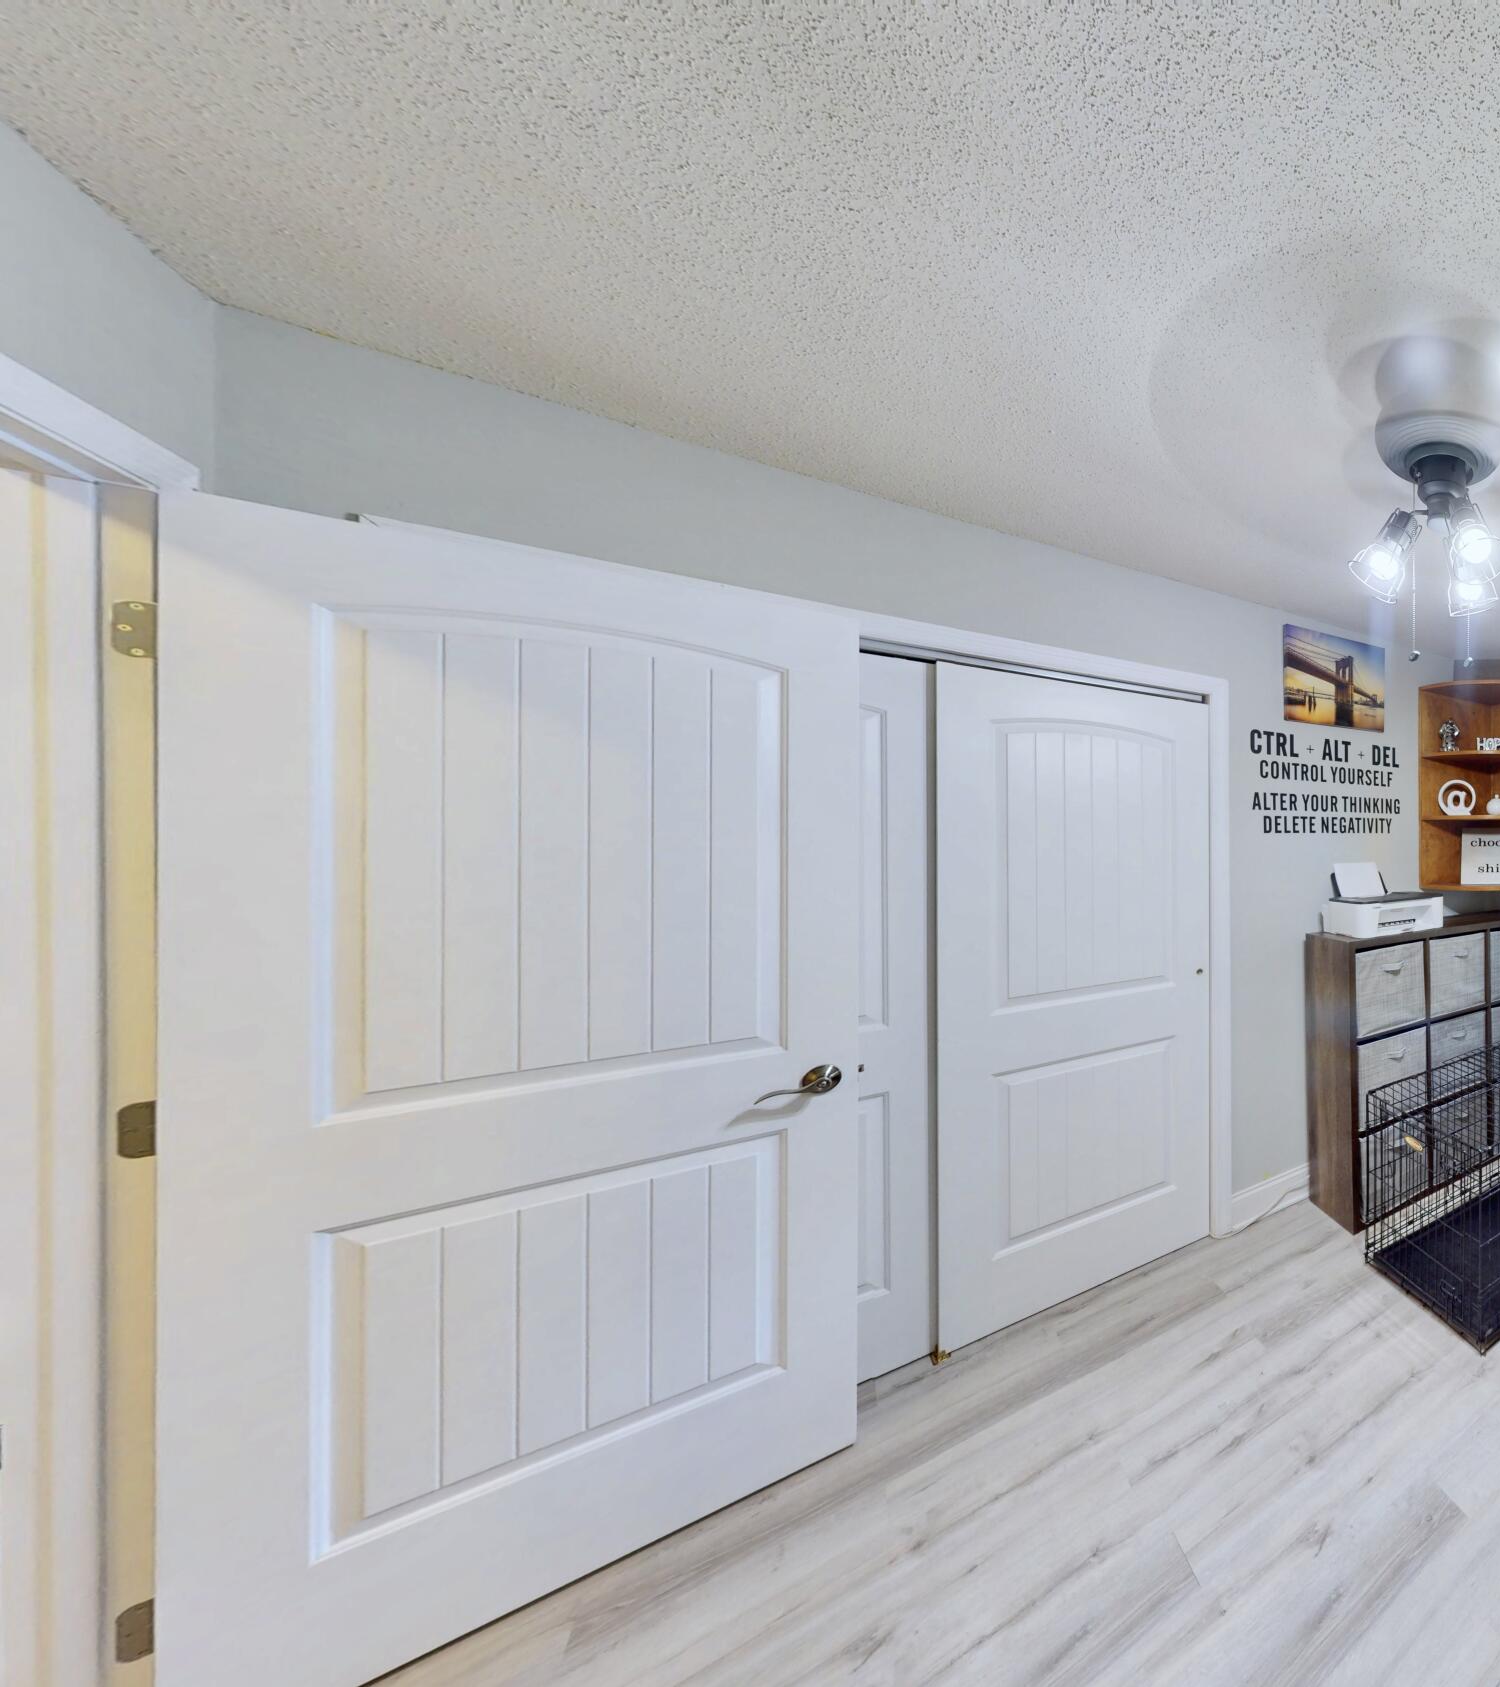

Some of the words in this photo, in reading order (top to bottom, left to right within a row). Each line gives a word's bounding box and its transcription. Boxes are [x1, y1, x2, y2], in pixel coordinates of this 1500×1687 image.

[1250, 729, 1299, 757] CTRL
[1322, 738, 1351, 762] ALT
[1372, 745, 1399, 768] DEL
[1260, 760, 1326, 782] CONTROL
[1330, 766, 1393, 787] YOURSELF
[1252, 792, 1298, 811] ALTER
[1302, 794, 1338, 812] YOUR
[1342, 796, 1400, 814] THINKING
[1264, 816, 1316, 833] DELETE
[1321, 816, 1392, 833] NEGATIVITY
